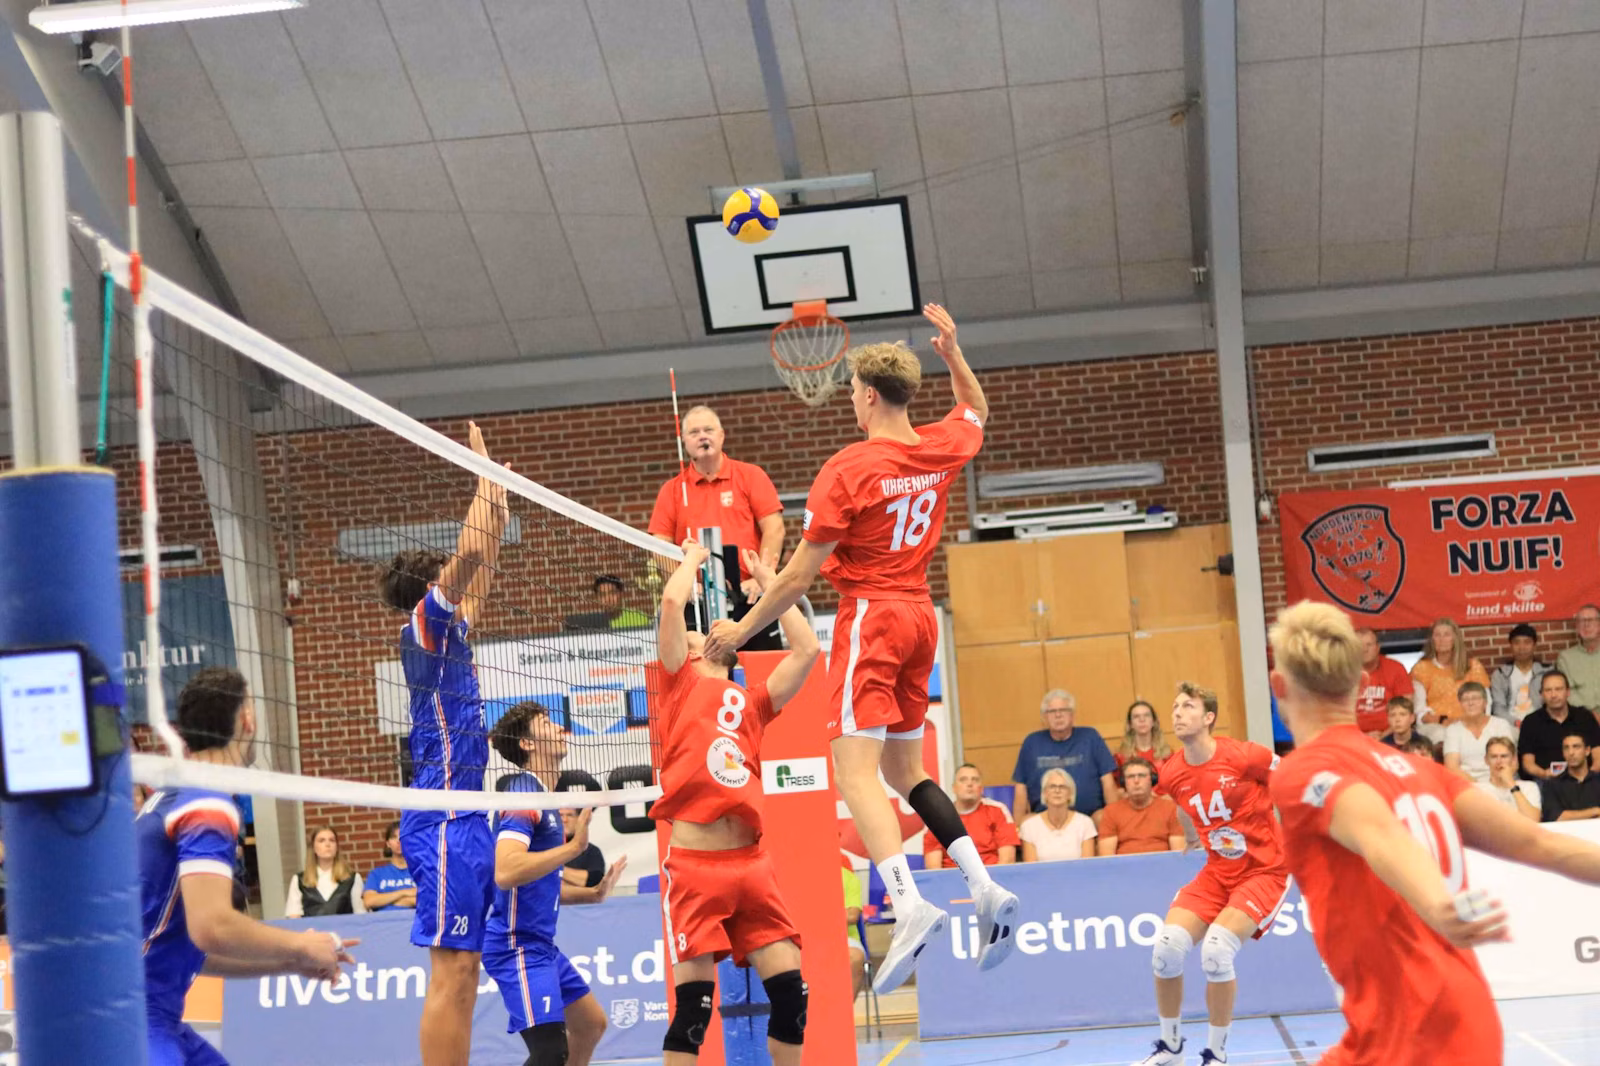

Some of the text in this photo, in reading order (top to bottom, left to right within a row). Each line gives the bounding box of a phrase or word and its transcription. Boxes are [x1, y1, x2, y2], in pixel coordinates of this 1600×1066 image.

[886, 489, 938, 551] 18
[1430, 489, 1576, 532] FORZA
[1342, 549, 1374, 567] 1976
[1448, 535, 1564, 576] NUIF!
[1466, 603, 1500, 616] lund
[1503, 601, 1546, 613] skilte
[519, 653, 562, 666] Service
[716, 687, 746, 731] 8
[784, 774, 816, 787] TRESS
[1189, 789, 1232, 826] 14
[1394, 792, 1465, 895] 10
[892, 866, 904, 886] CRAFT
[451, 915, 469, 936] 28
[678, 932, 687, 951] 8
